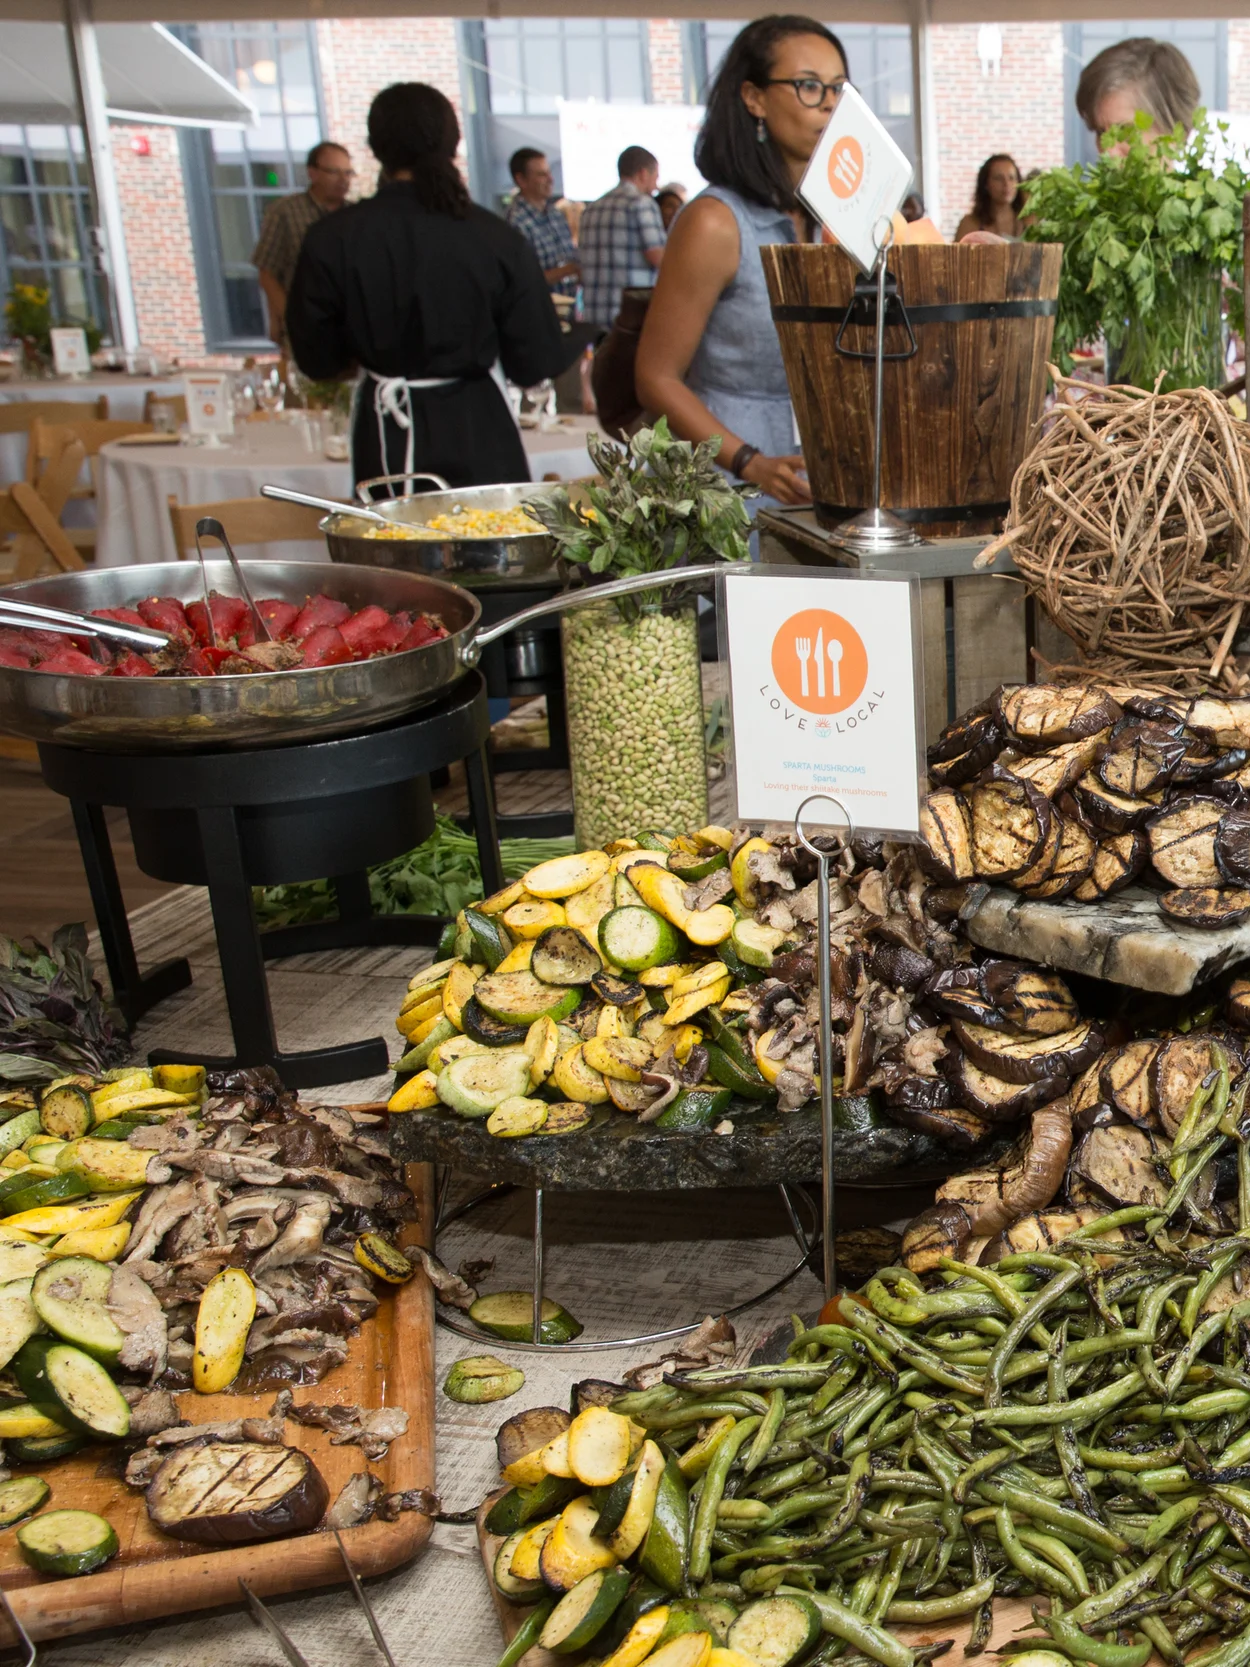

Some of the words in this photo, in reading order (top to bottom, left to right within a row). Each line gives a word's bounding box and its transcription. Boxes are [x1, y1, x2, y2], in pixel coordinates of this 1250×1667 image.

[760, 684, 808, 731] LOVE
[836, 690, 885, 733] LOCAL
[783, 760, 812, 771] SPARTA
[814, 763, 866, 774] MUSHROOMS
[812, 774, 837, 783] Sparta
[764, 782, 790, 792] Loving
[791, 783, 809, 792] their
[811, 784, 840, 794] shiitake
[842, 788, 888, 797] mushrooms
